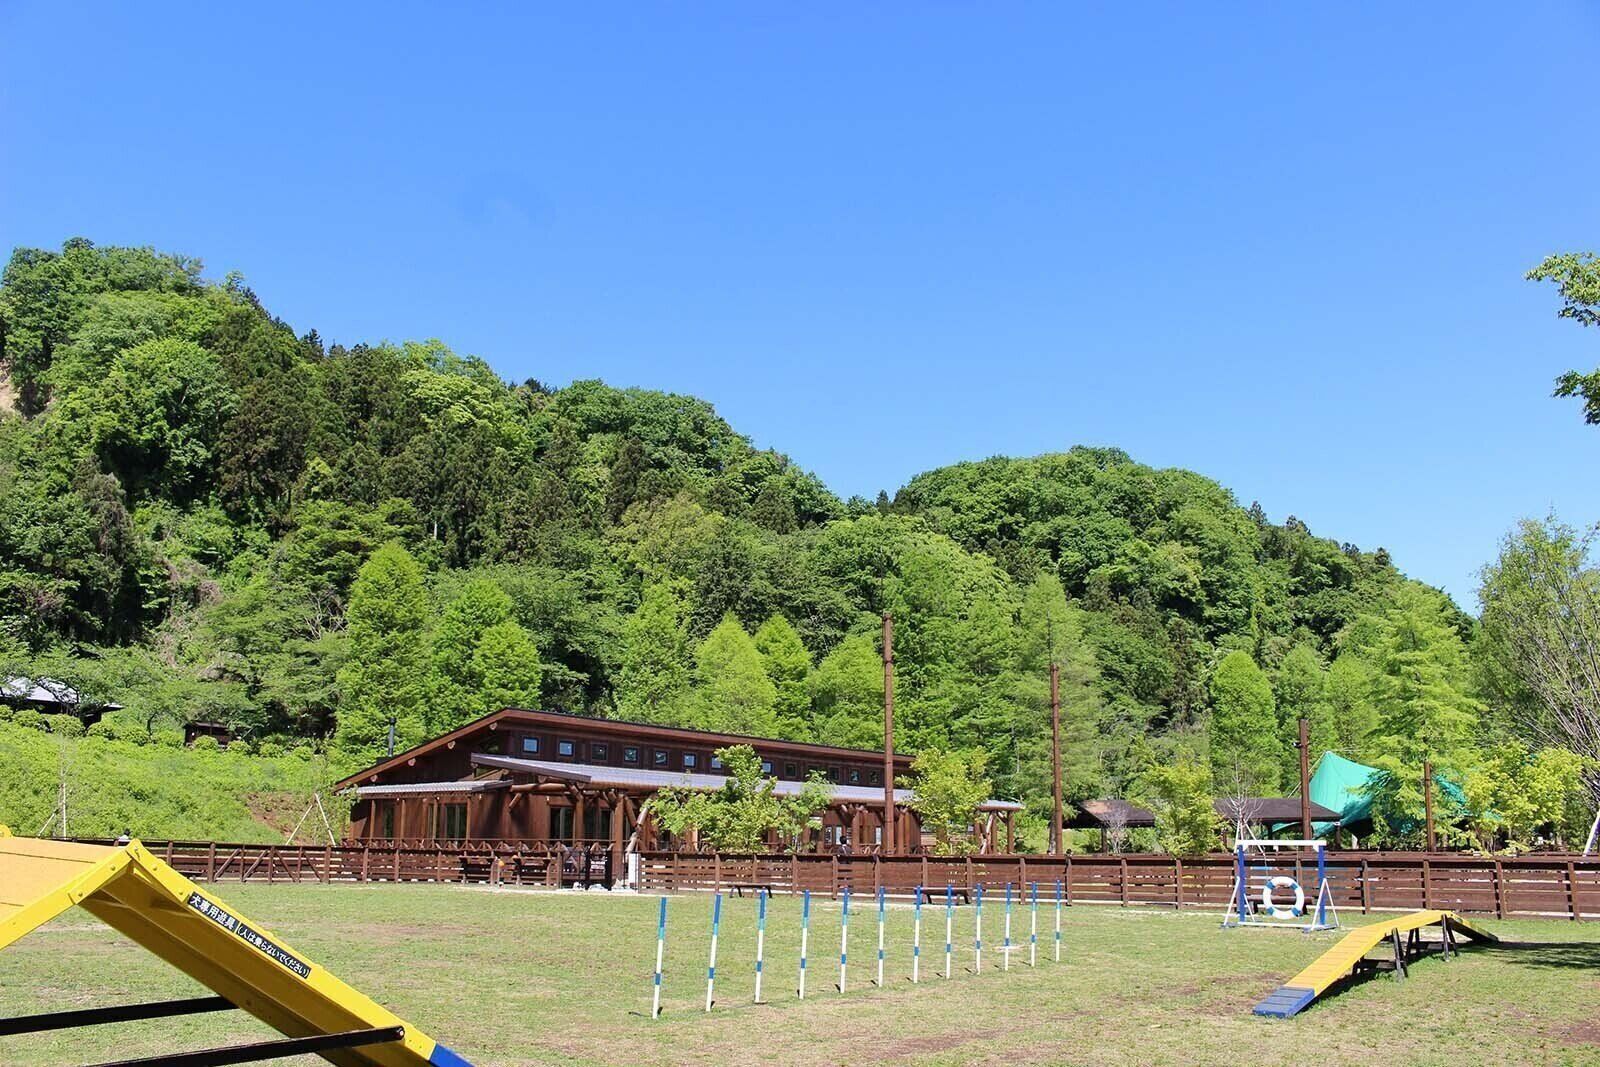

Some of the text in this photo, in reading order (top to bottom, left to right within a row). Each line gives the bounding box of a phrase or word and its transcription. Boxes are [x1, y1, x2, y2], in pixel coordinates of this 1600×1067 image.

[190, 895, 235, 930] 犬専用遊具
